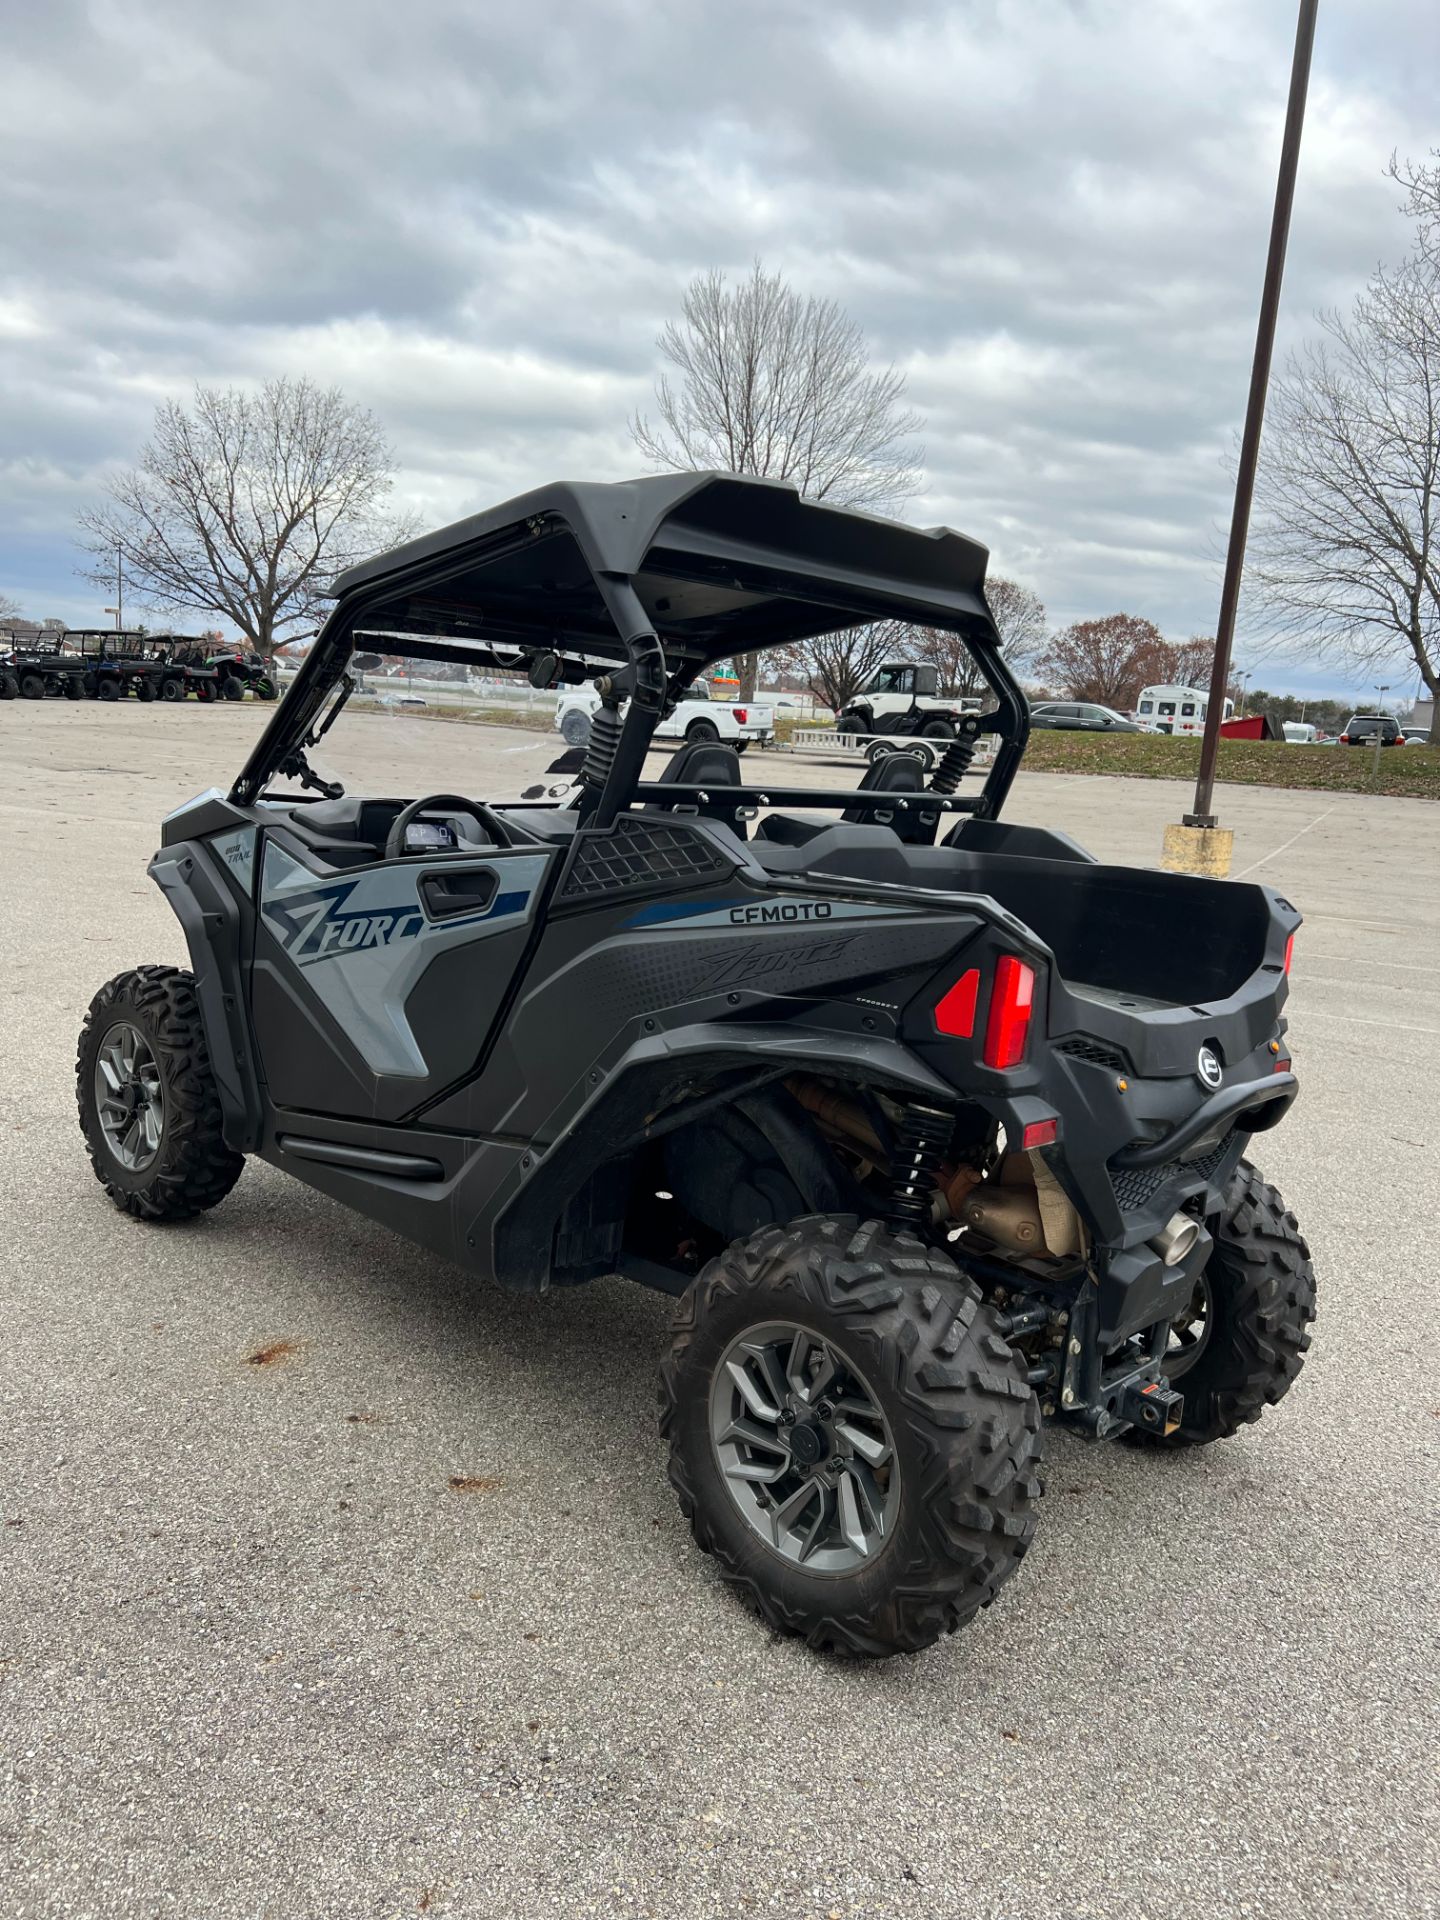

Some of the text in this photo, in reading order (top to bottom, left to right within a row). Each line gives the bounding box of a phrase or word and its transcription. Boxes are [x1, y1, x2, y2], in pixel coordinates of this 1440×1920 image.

[228, 850, 252, 864] TRAIL
[729, 902, 832, 924] CFMOTO
[283, 895, 430, 957] ZFORC
